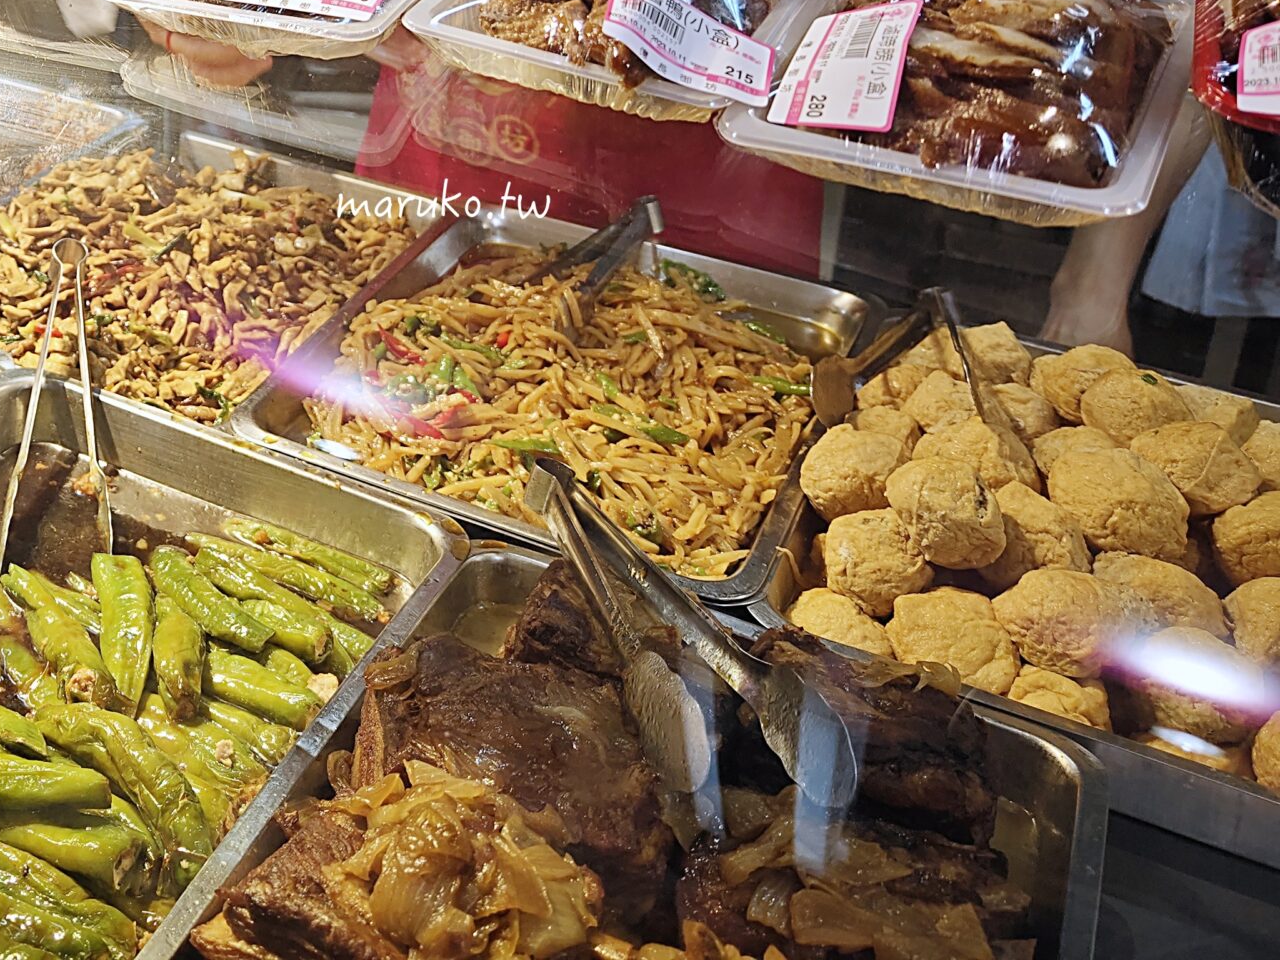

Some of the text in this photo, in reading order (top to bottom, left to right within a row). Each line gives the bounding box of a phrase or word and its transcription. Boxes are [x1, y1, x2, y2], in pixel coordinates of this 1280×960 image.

[725, 65, 754, 85] 215
[1244, 76, 1280, 87] 2023.1
[807, 95, 827, 118] 280
